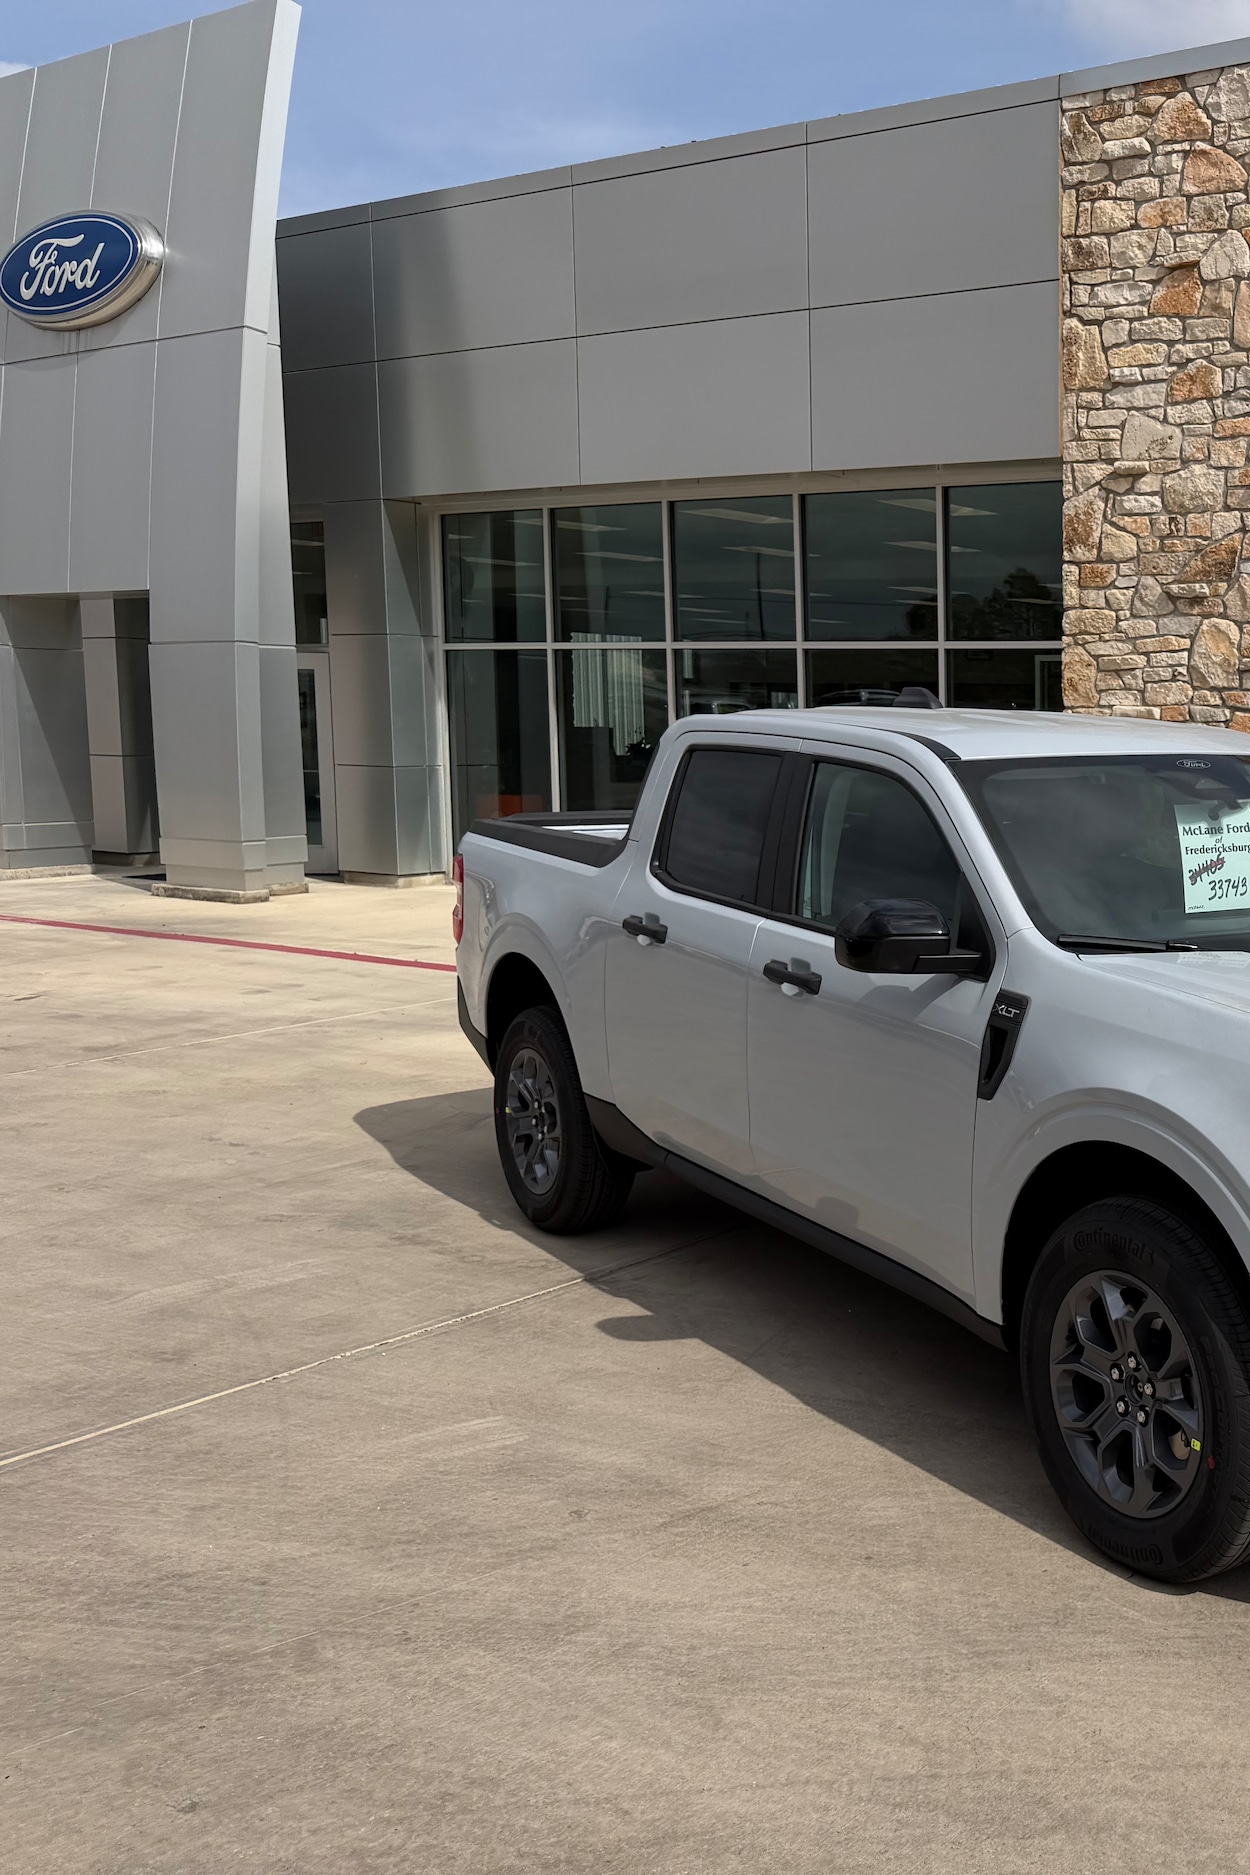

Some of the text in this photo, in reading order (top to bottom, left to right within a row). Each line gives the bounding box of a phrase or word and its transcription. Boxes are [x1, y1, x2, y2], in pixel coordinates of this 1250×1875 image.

[20, 233, 105, 300] Ford
[1182, 822, 1250, 836] McLane Ford
[1215, 836, 1223, 844] of
[1208, 876, 1248, 901] 33743
[992, 1003, 1020, 1018] XLT
[1073, 1227, 1147, 1260] Continental
